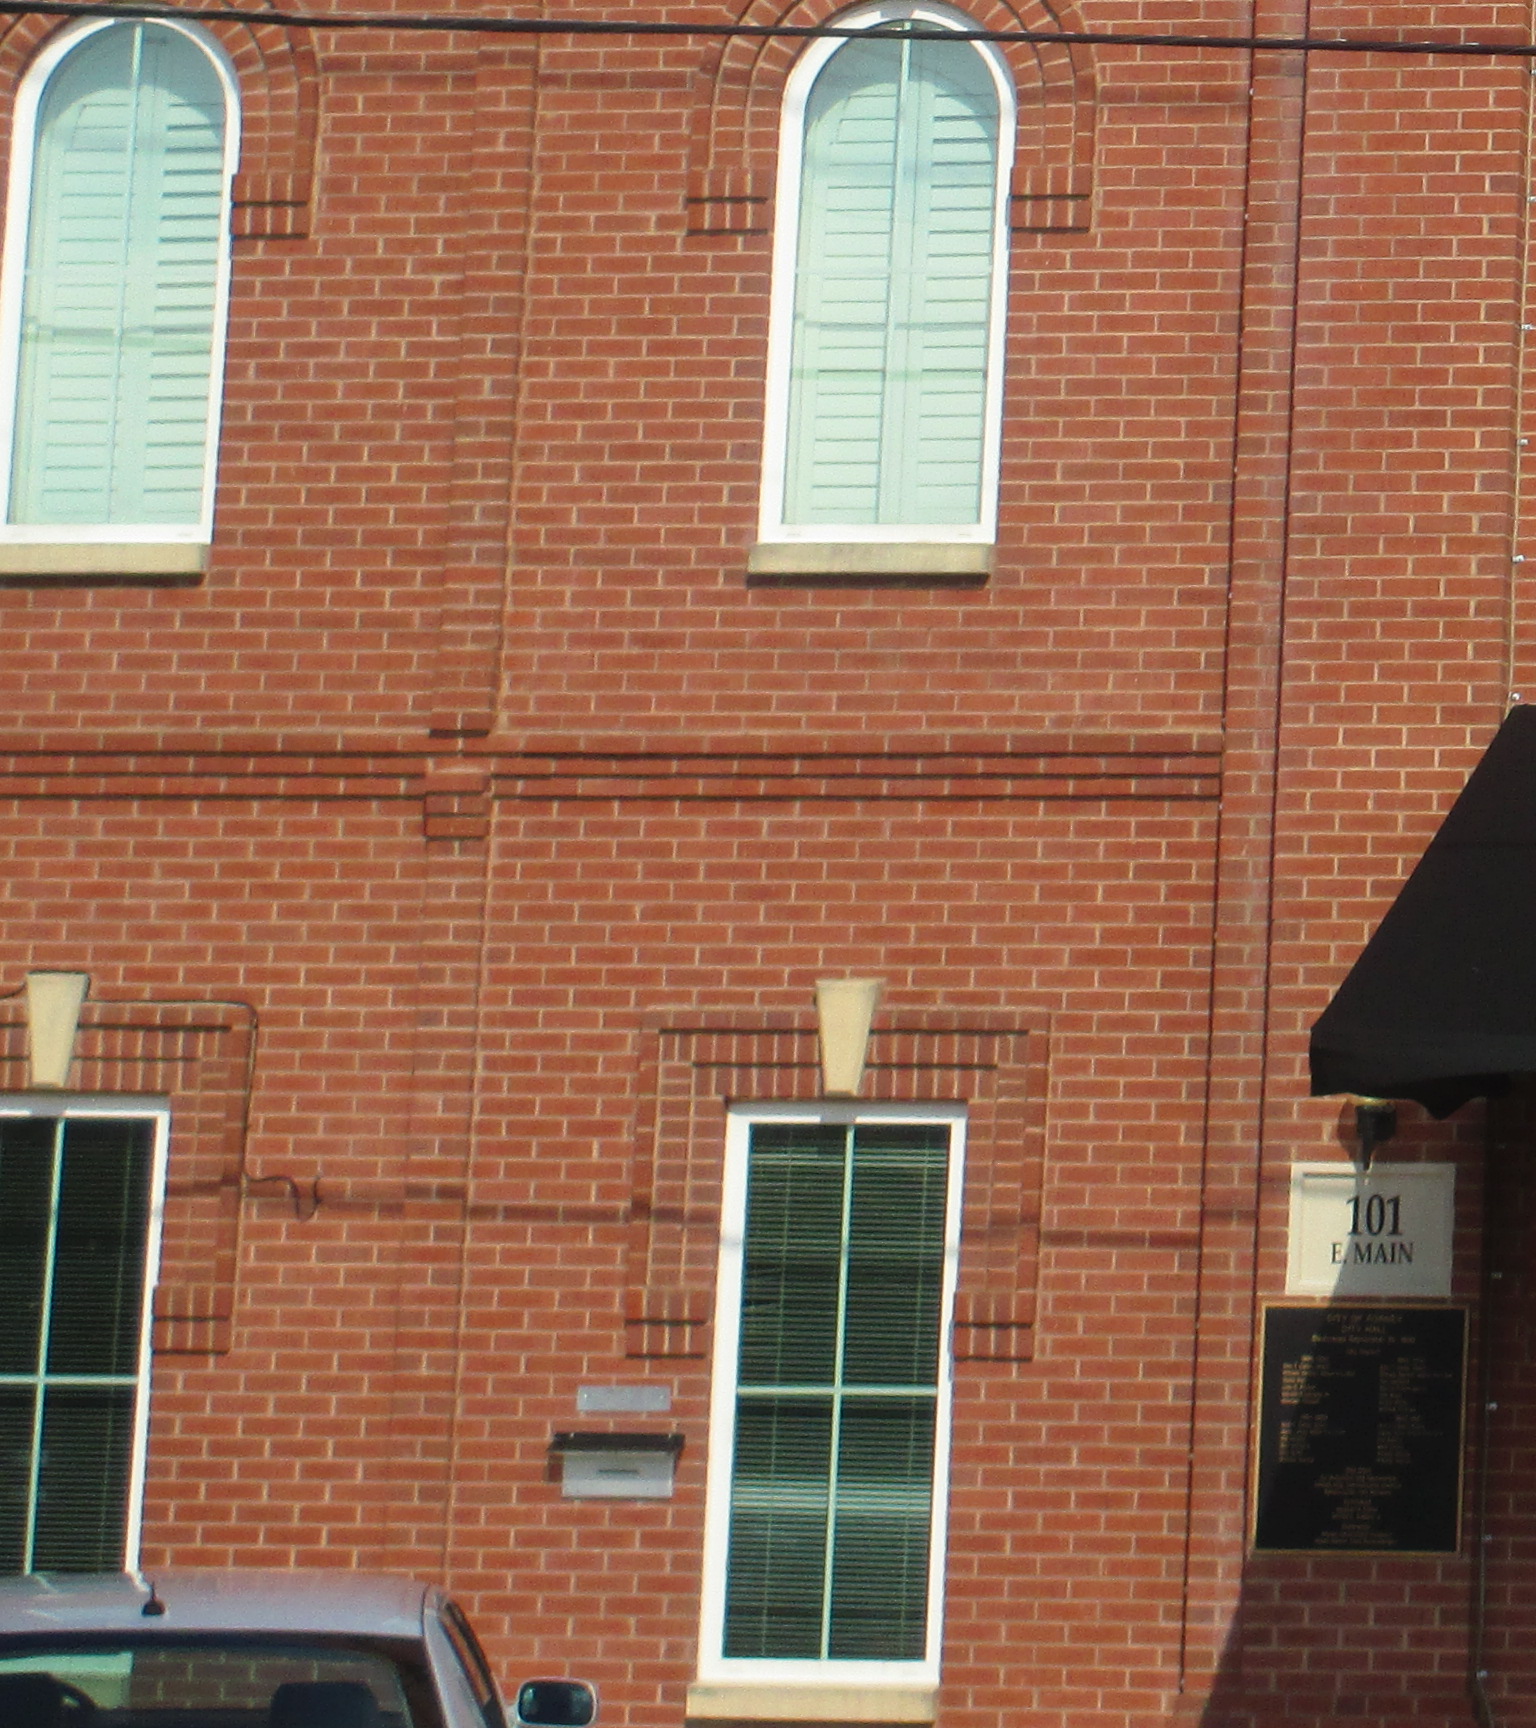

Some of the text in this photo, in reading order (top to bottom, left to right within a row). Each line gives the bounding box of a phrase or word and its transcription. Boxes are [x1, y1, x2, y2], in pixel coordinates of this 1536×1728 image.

[1345, 1194, 1403, 1236] 101
[1331, 1242, 1415, 1265] E. MAIN
